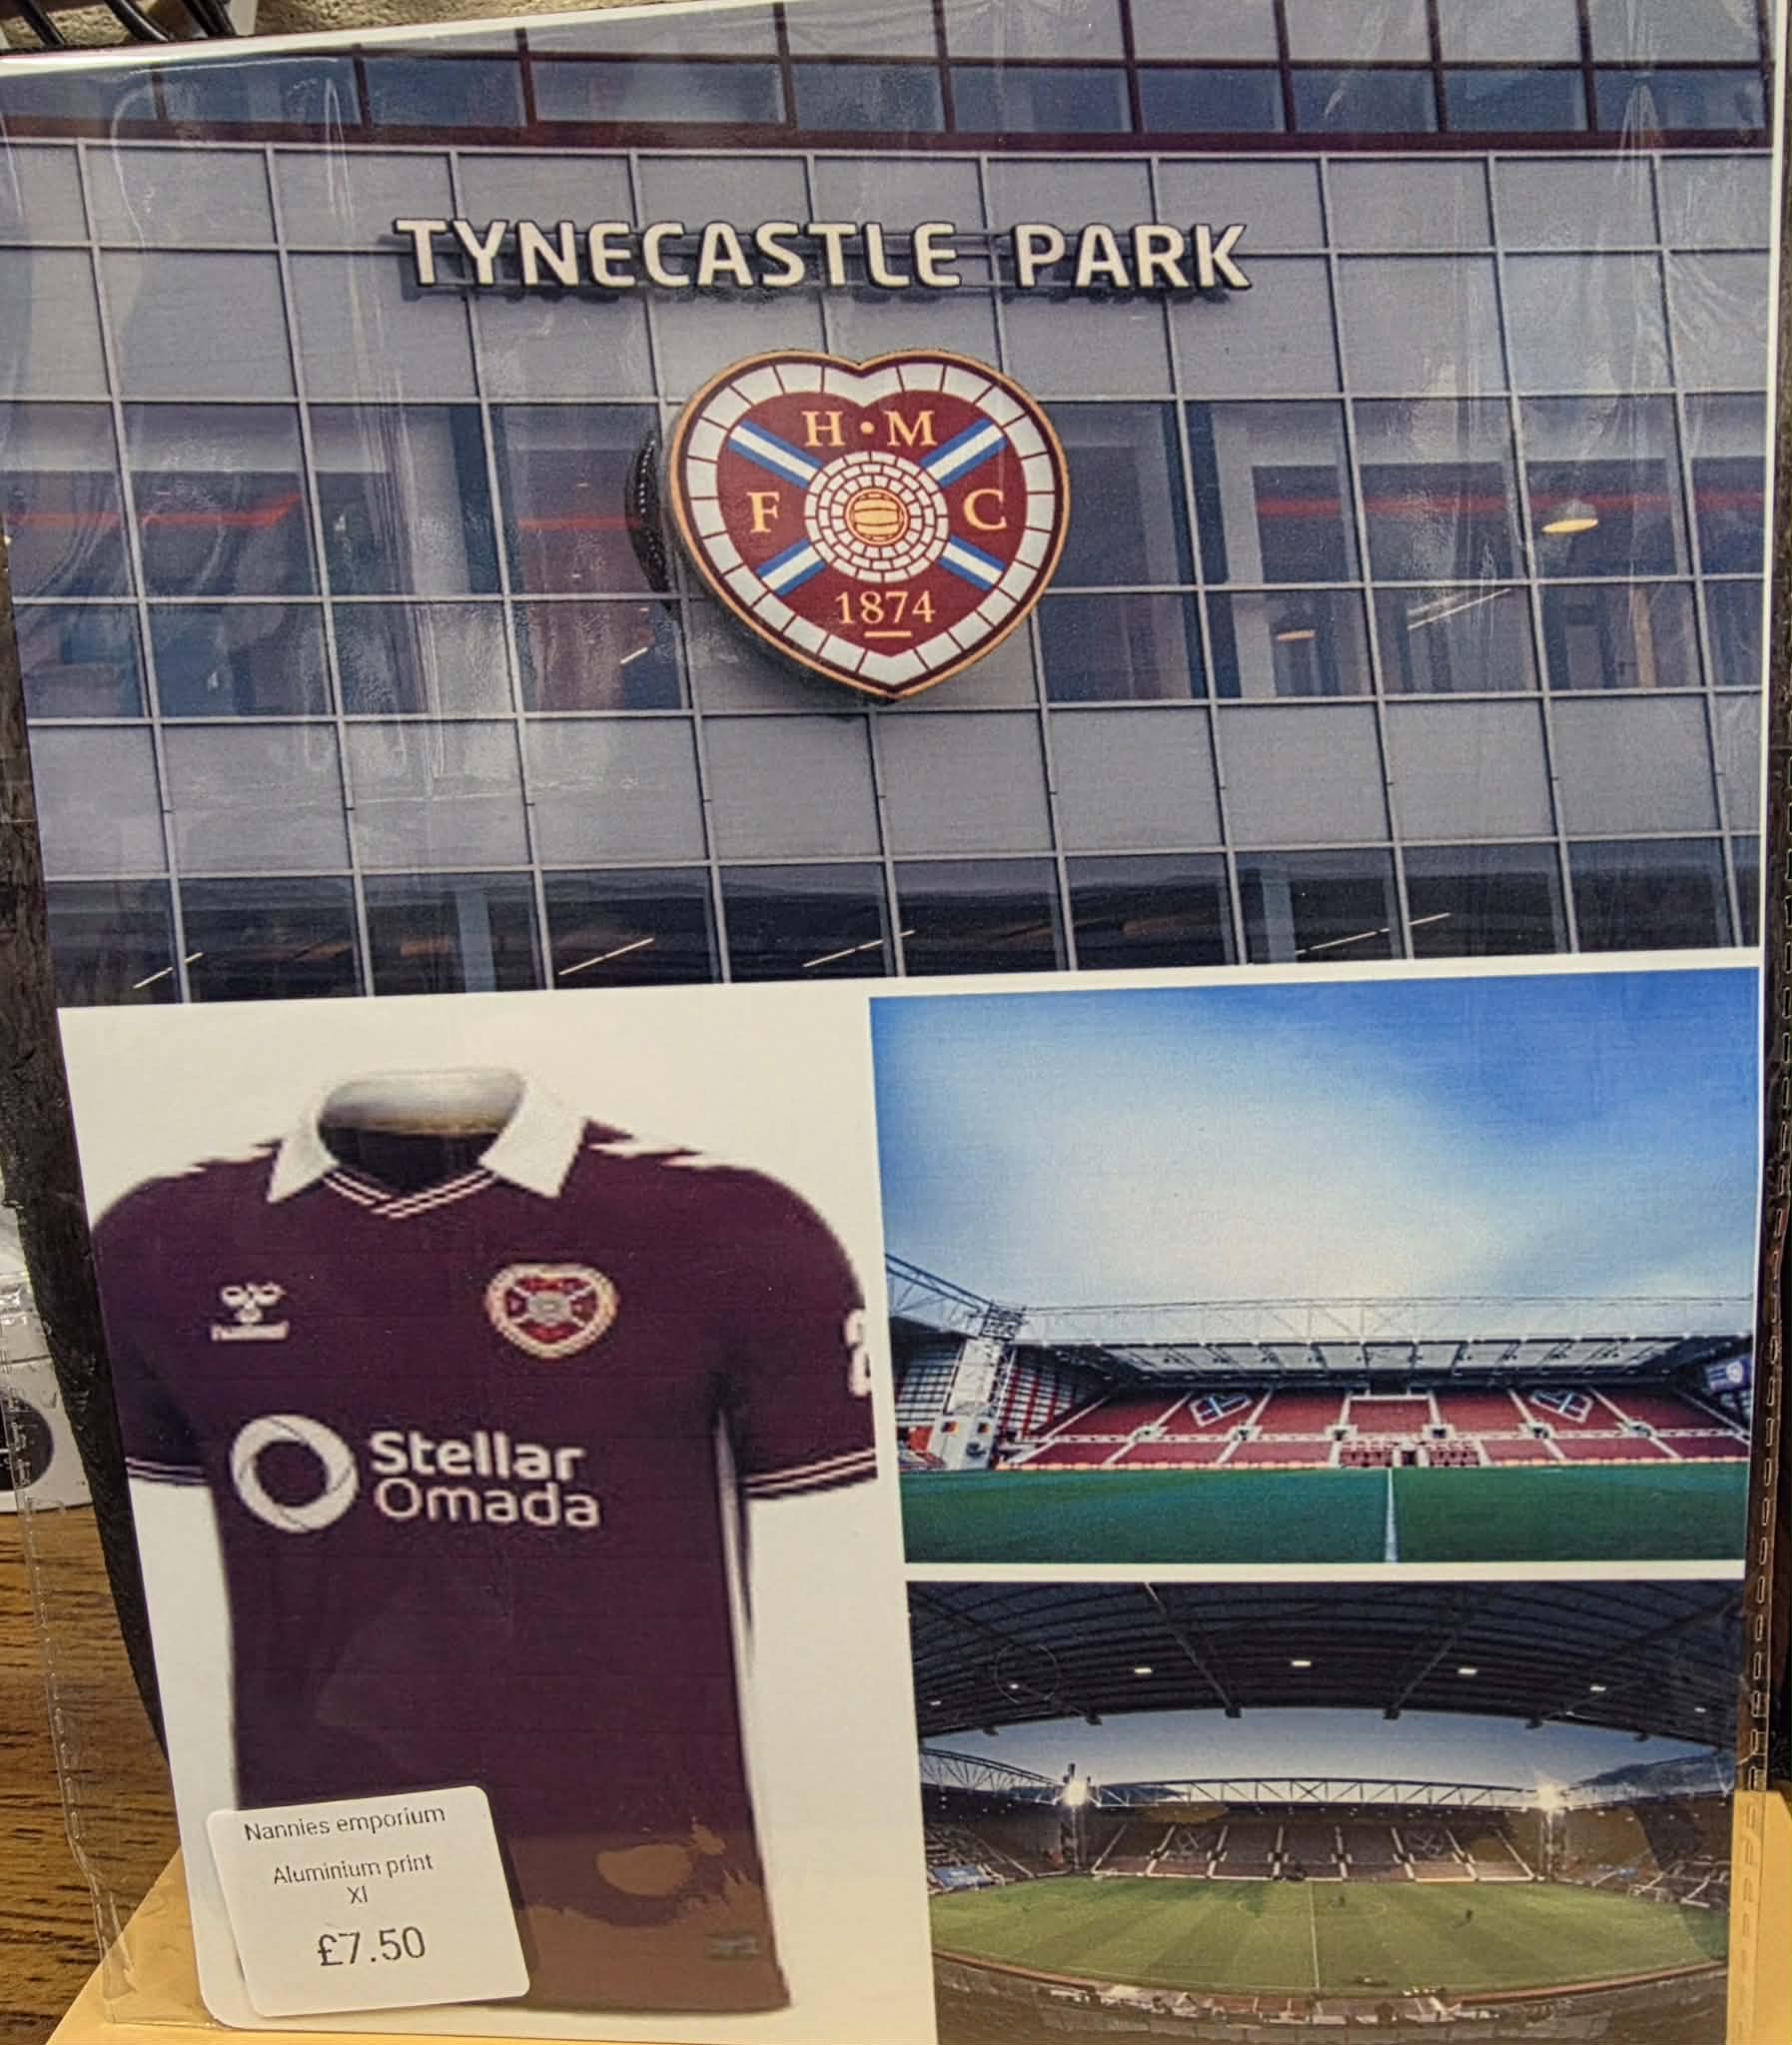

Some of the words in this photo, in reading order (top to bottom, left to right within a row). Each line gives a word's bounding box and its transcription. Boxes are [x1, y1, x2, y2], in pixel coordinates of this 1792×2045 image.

[394, 218, 962, 291] TYNECASTLE
[1014, 223, 1253, 291] PARK
[805, 410, 846, 449] H
[886, 409, 937, 447] M
[747, 491, 781, 533] F
[963, 488, 1007, 531] C
[836, 589, 937, 626] 1874
[370, 1430, 585, 1479] Stellar
[374, 1477, 601, 1529] Omada
[244, 1818, 331, 1841] Nannies
[336, 1805, 447, 1834] emporium
[273, 1858, 383, 1885] Aluminium
[387, 1853, 434, 1878] print
[317, 1925, 427, 1967] £7.50
